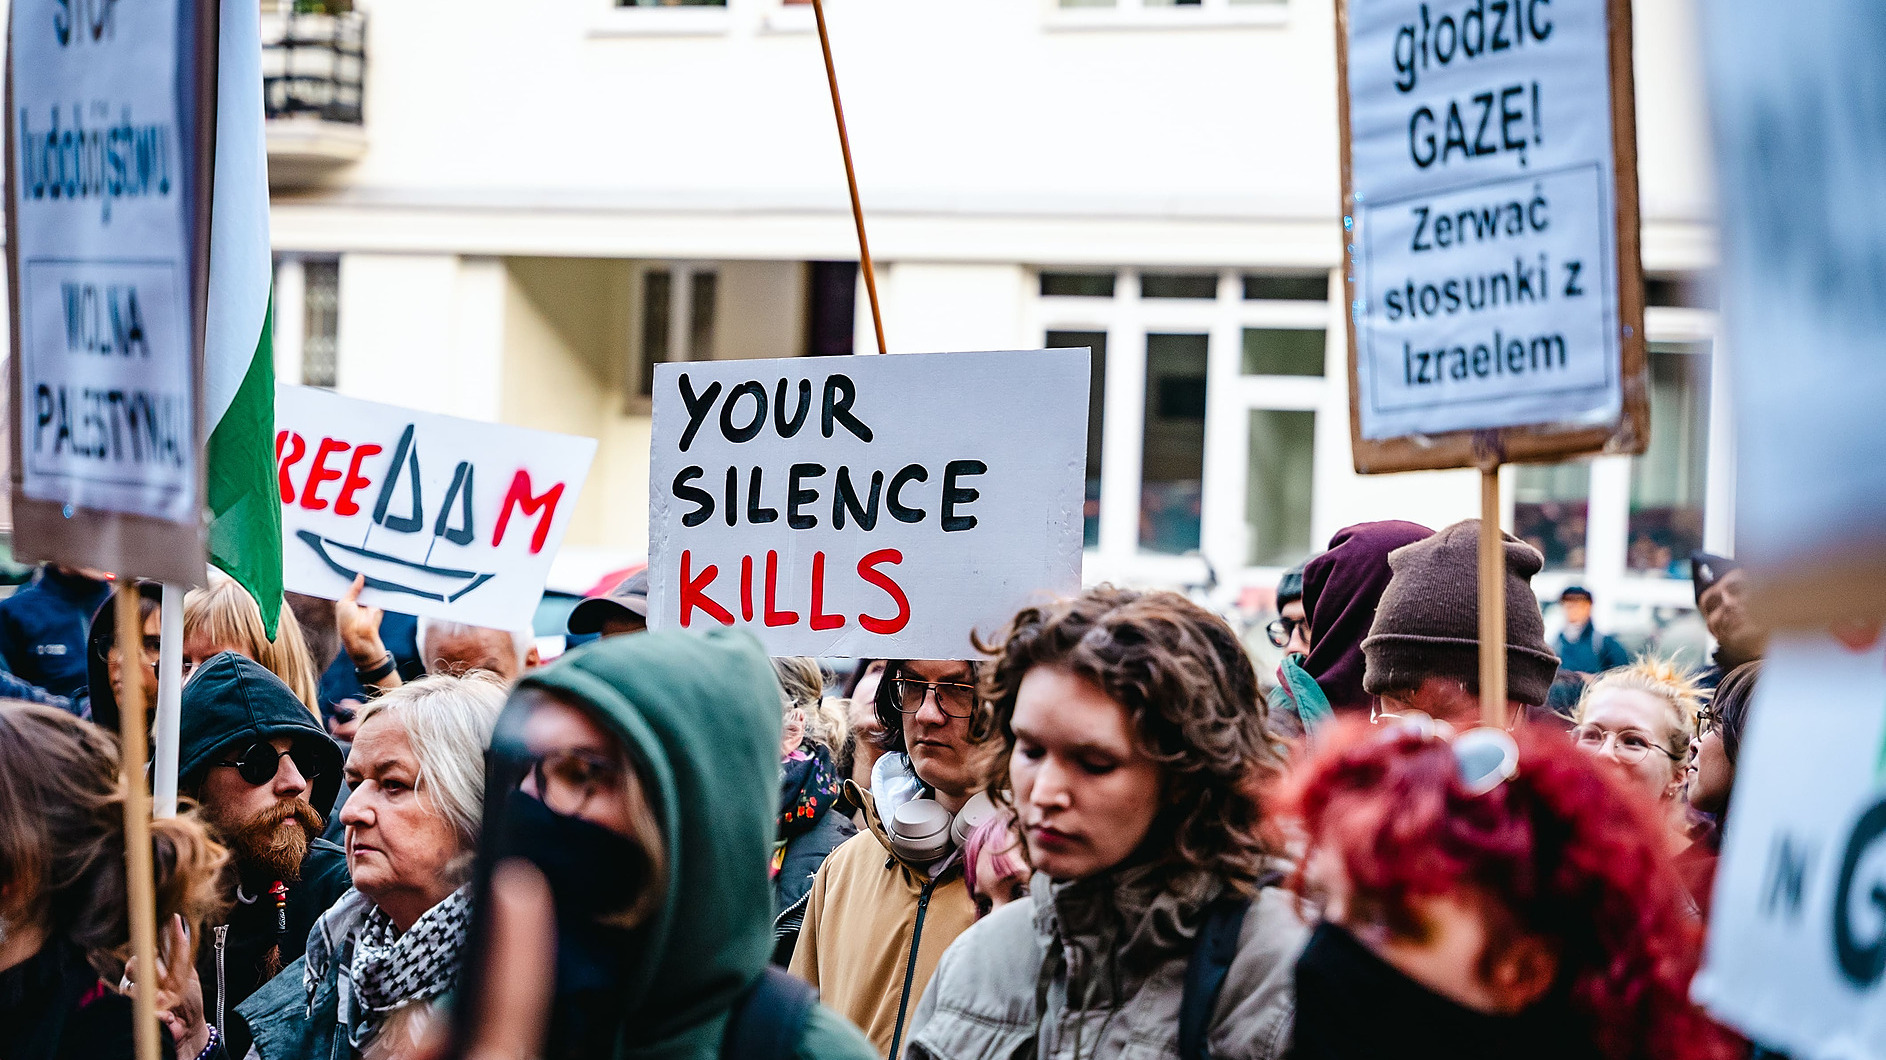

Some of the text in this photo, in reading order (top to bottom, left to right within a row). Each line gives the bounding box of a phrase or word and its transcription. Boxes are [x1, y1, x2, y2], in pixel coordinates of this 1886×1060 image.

[1409, 81, 1541, 168] GAZĘ!
[1411, 183, 1549, 252] Zerwać
[1385, 253, 1583, 321] stosunki z
[1404, 330, 1567, 386] Izraelem
[678, 373, 874, 453] YOUR
[672, 460, 988, 532] SILENCE
[679, 548, 911, 635] KILLS
